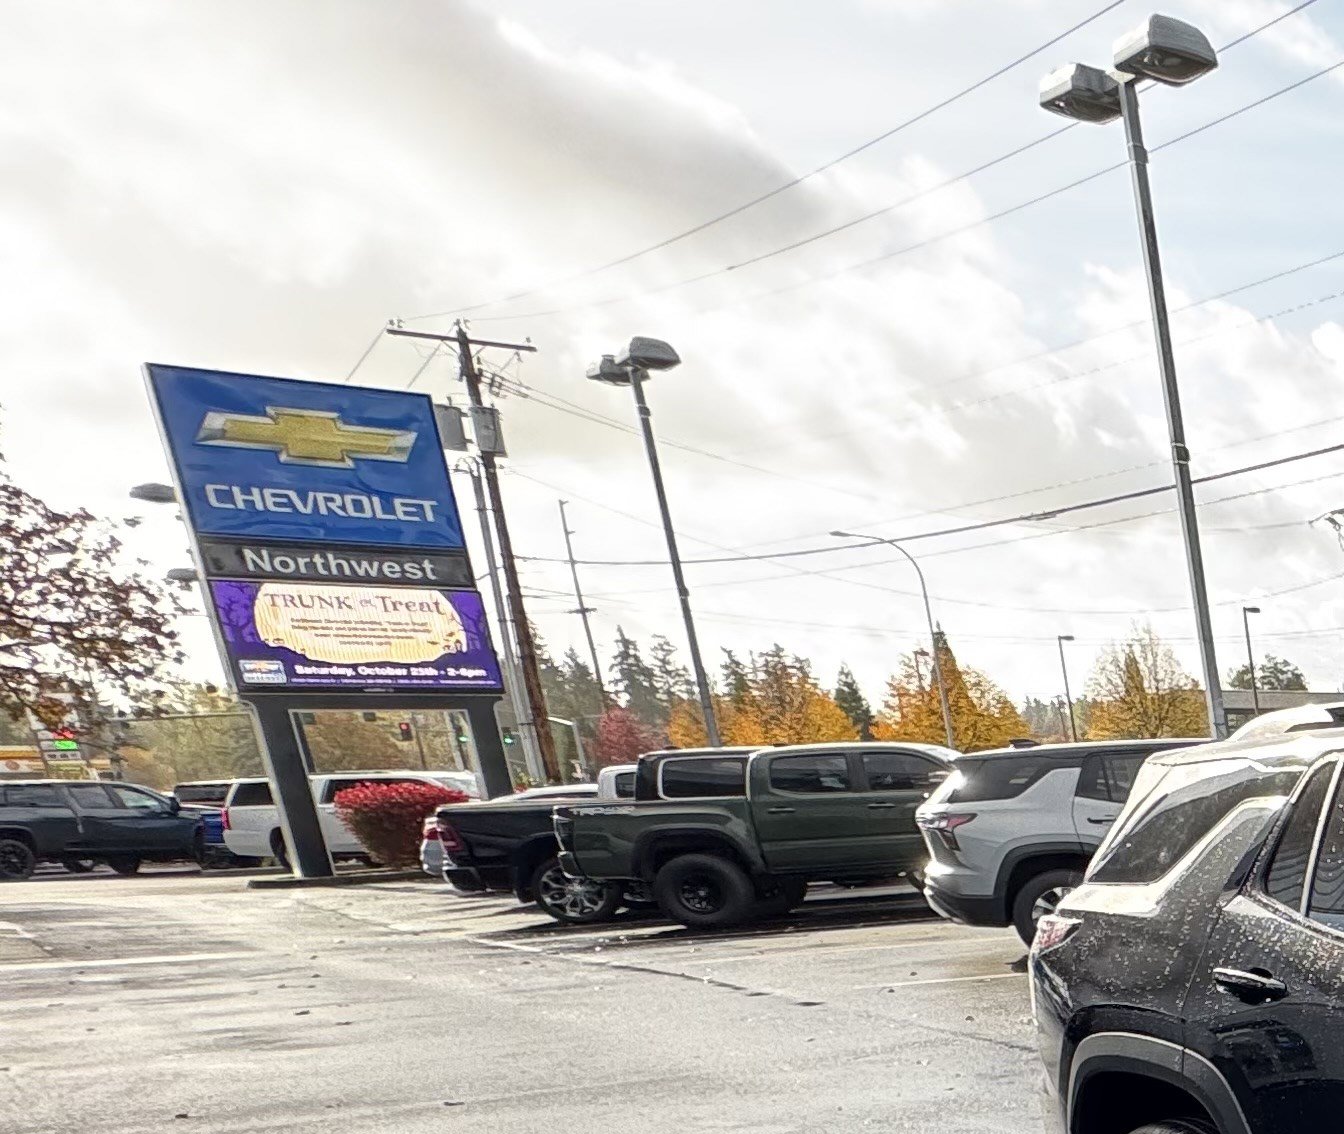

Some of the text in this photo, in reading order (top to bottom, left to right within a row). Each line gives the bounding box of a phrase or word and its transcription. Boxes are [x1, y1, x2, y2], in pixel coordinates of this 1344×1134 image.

[204, 484, 439, 523] CHEVROLET
[241, 548, 438, 581] Northwest
[263, 593, 353, 610] TRUNK
[375, 595, 446, 616] Treat
